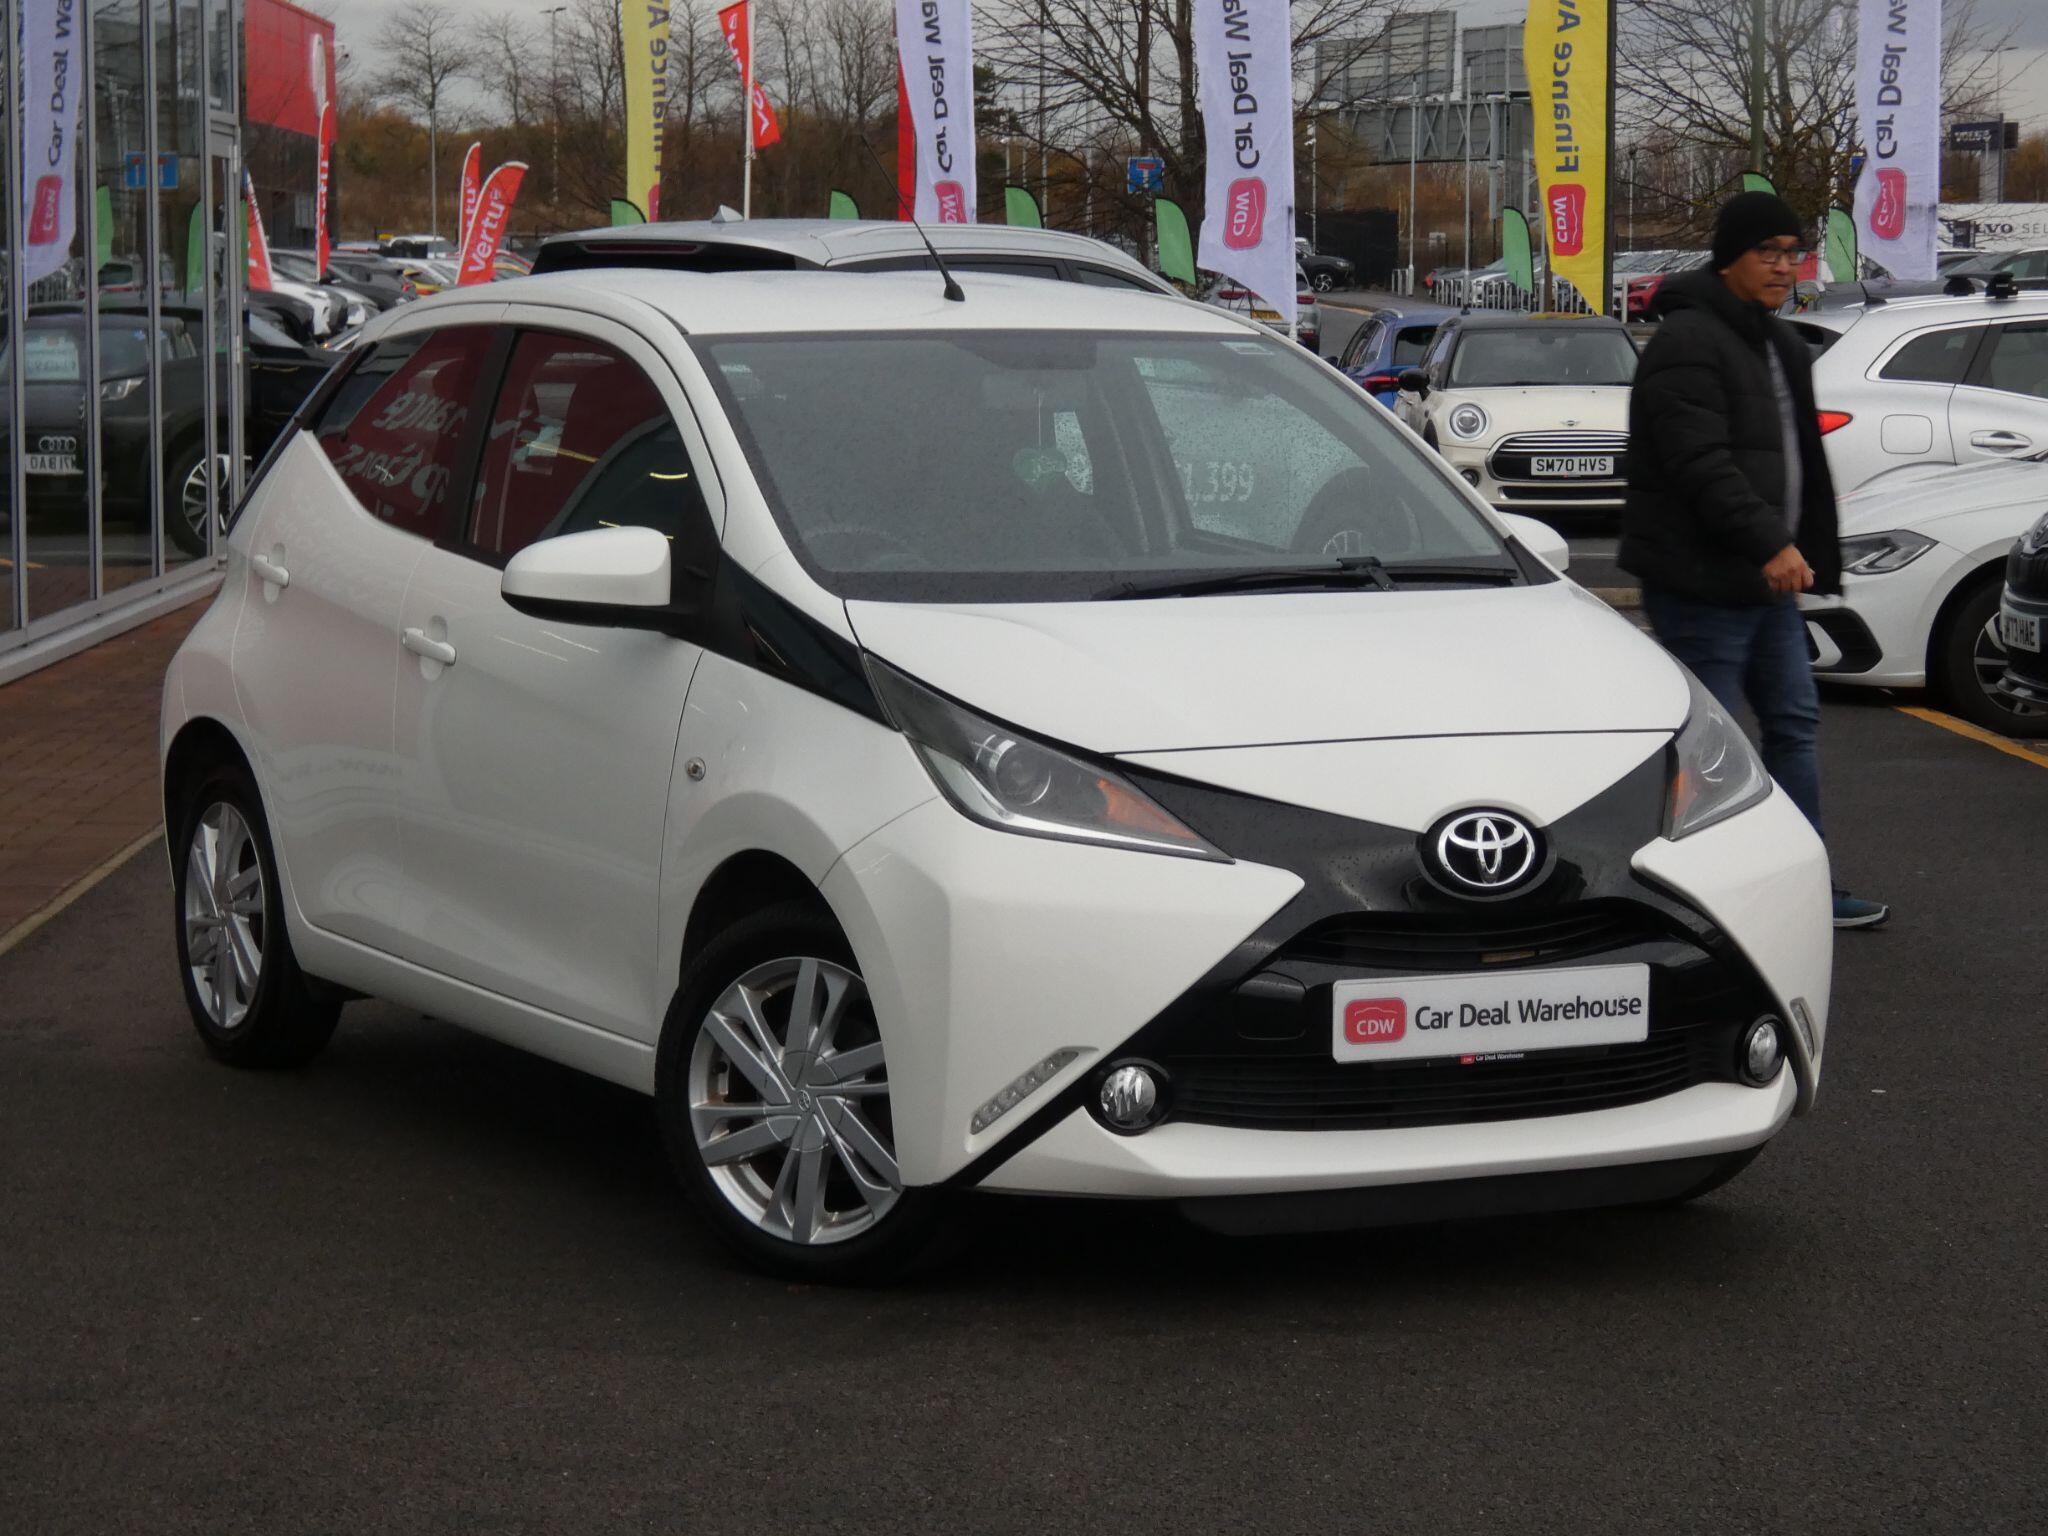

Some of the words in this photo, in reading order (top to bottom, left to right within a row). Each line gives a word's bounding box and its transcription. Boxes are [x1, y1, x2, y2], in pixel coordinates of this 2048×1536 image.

[50, 50, 69, 113] Deal
[48, 119, 63, 167] Car
[468, 200, 506, 271] Vertu
[1536, 458, 1574, 472] SM70
[1579, 458, 1607, 471] HVS
[1356, 1018, 1395, 1036] CDW
[1415, 1005, 1453, 1030] Car
[1459, 1000, 1511, 1028] Deal
[1517, 995, 1642, 1023] Warehouse
